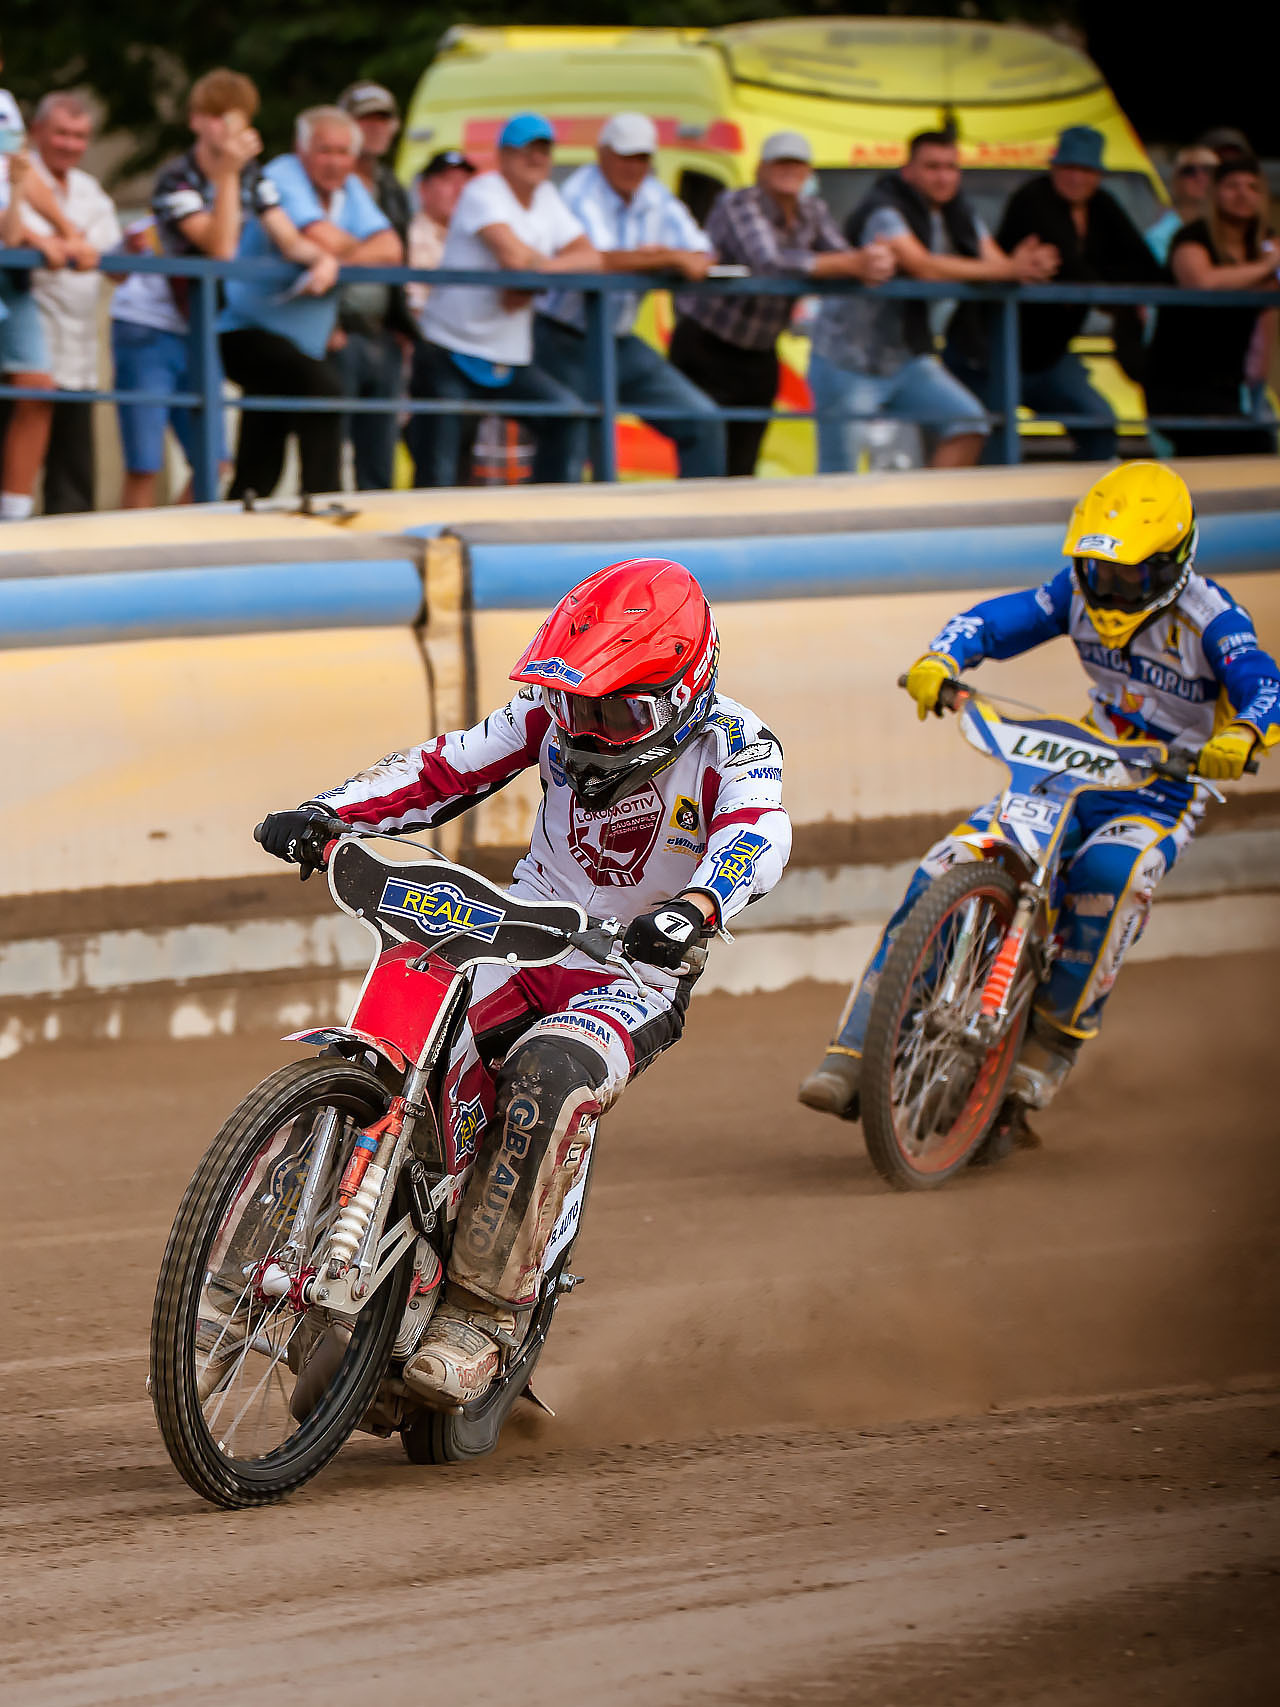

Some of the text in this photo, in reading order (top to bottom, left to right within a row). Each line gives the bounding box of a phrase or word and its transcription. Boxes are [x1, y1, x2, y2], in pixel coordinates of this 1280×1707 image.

[1011, 736, 1115, 778] LAVOR
[575, 795, 655, 824] LOKOMOTIV
[1006, 797, 1057, 822] FST
[719, 841, 760, 886] REALL
[402, 890, 475, 928] REALL
[470, 1162, 516, 1251] AUTO
